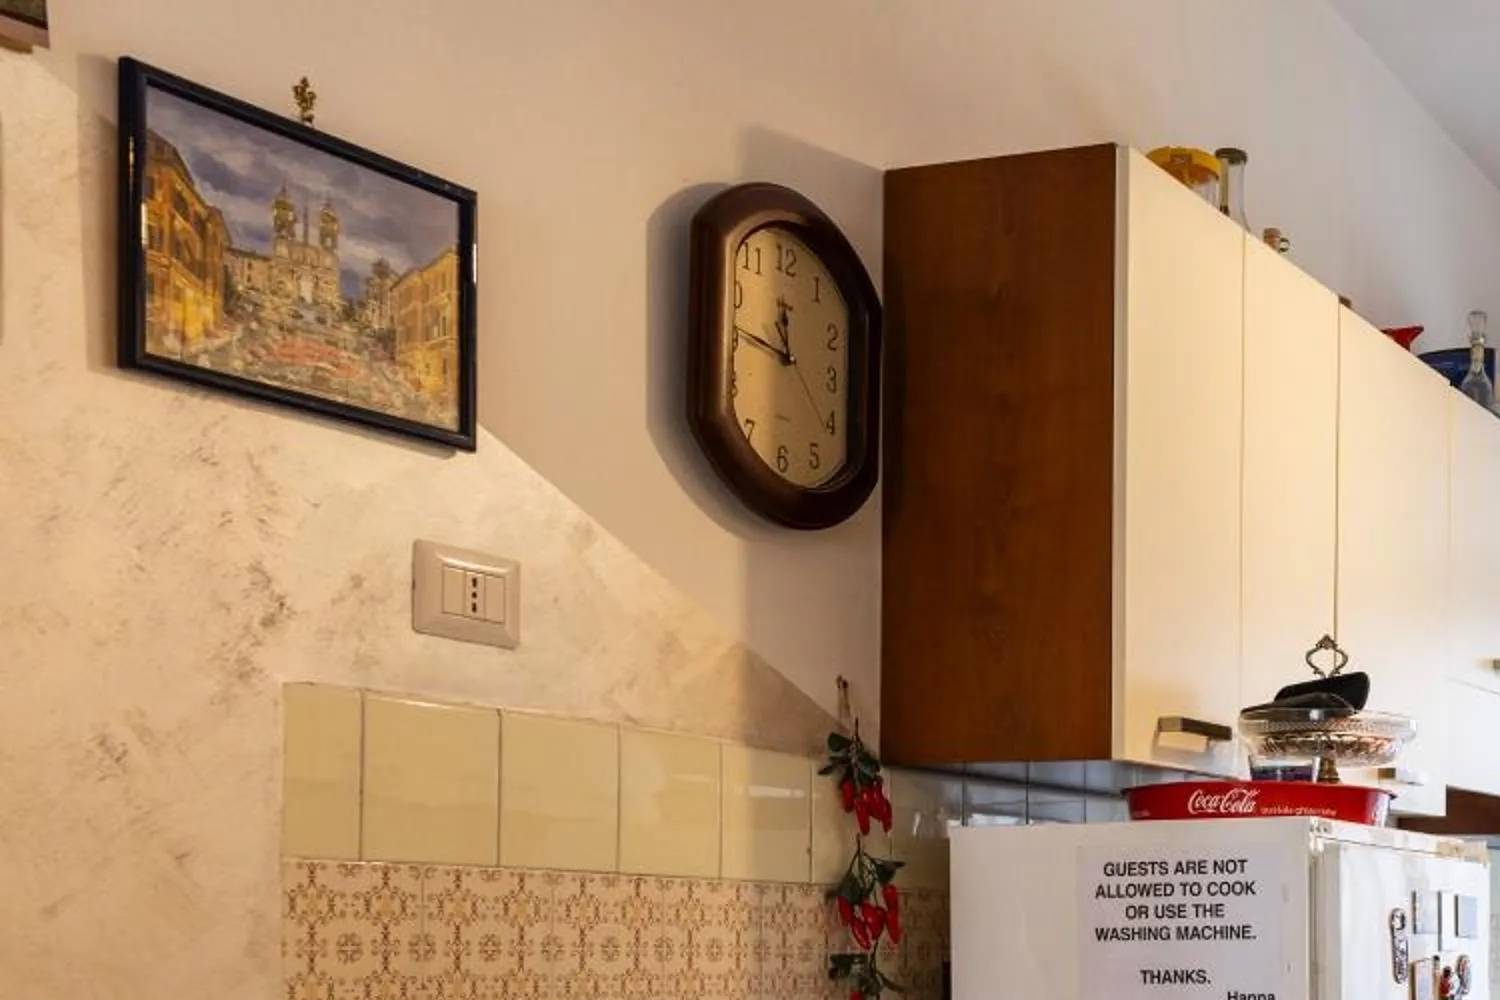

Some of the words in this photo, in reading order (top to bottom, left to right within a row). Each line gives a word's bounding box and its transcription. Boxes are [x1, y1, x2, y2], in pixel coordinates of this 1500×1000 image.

[741, 242, 762, 276] 11
[776, 242, 797, 277] 12
[812, 276, 821, 304] 1
[826, 322, 838, 351] 2
[825, 367, 838, 394] 3
[825, 410, 836, 436] 4
[776, 445, 789, 473] 6
[809, 442, 820, 470] 5
[1103, 861, 1169, 877] GUESTS
[1174, 860, 1208, 875] ARE
[1212, 859, 1248, 874] NOT
[1095, 883, 1174, 899] ALLOWED
[1179, 882, 1201, 896] TO
[1207, 881, 1257, 896] COOK
[1125, 905, 1149, 920] OR
[1154, 904, 1187, 919] USE
[1192, 903, 1225, 918] THE
[1095, 927, 1171, 942] WASHING
[1175, 925, 1257, 941] MACHINE.
[1139, 969, 1212, 985] THANKS.
